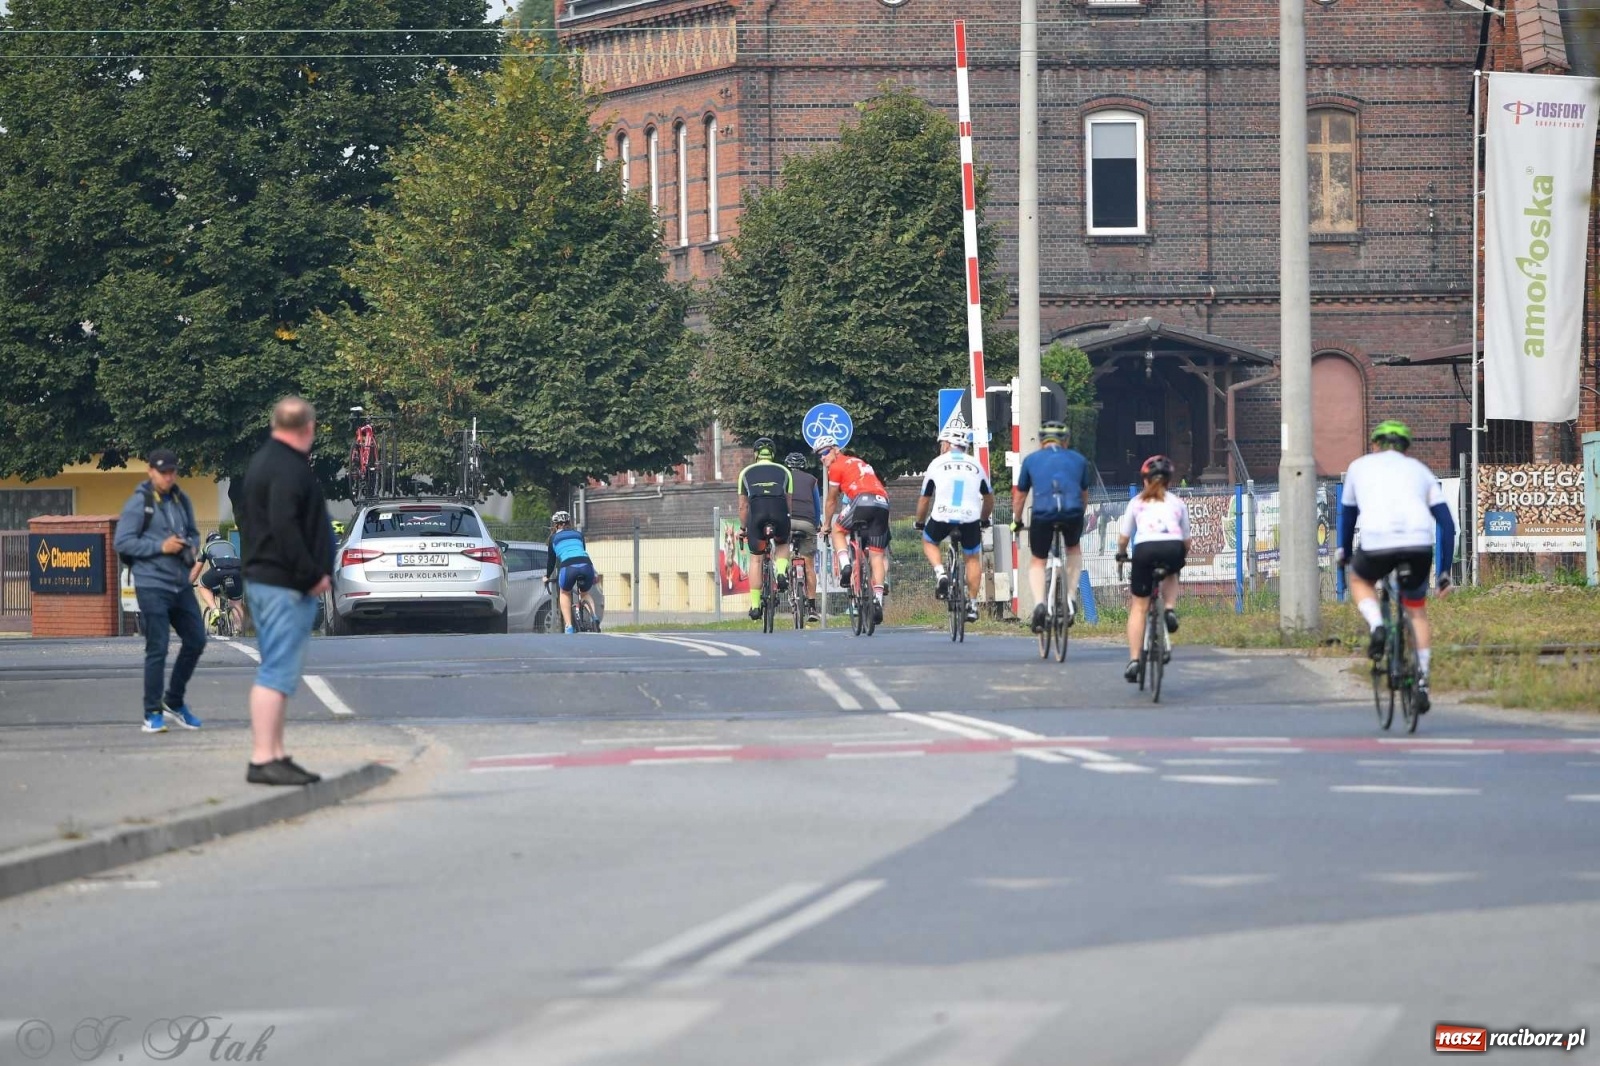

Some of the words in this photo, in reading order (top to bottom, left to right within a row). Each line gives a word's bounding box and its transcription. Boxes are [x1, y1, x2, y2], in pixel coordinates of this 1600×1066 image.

[1536, 102, 1586, 119] FOSFORY
[1496, 471, 1584, 489] POTĘGA
[51, 547, 91, 571] Chempest
[403, 555, 415, 564] SG
[418, 554, 446, 564] 9347V
